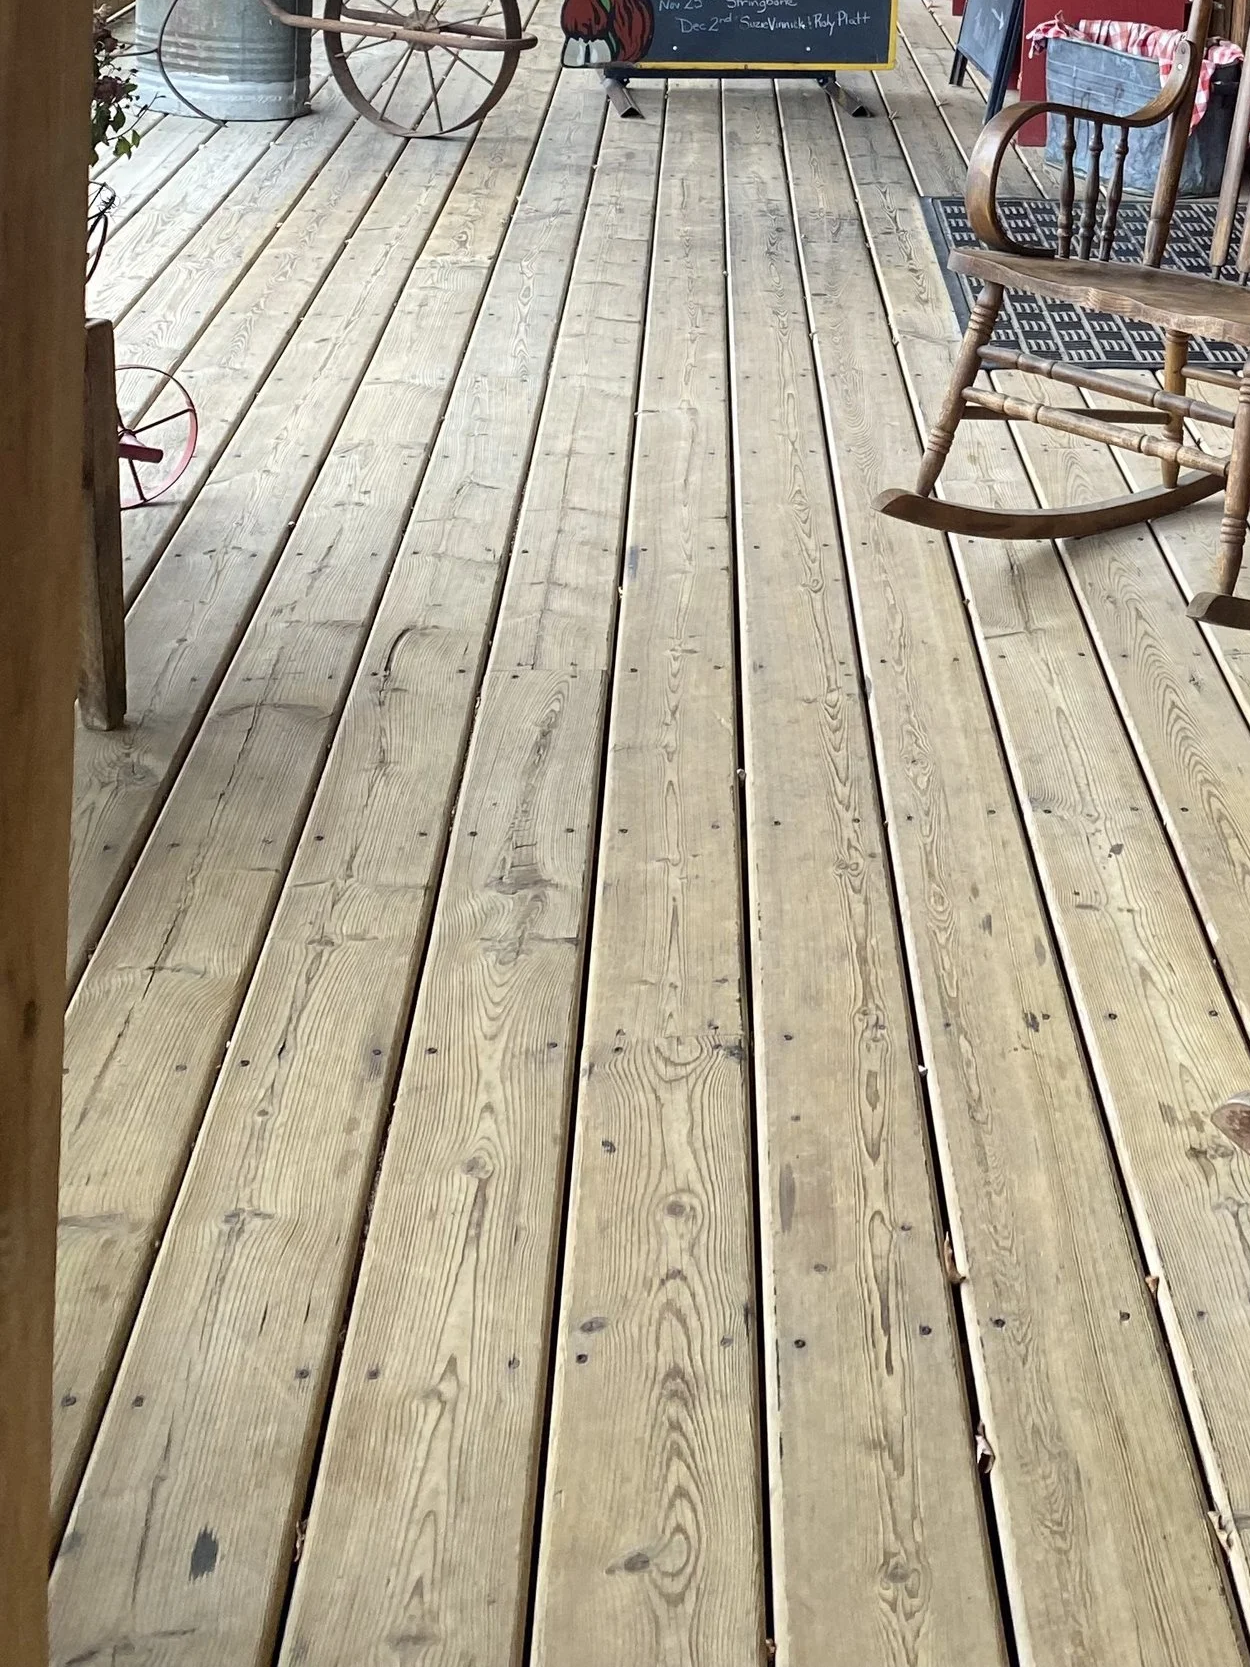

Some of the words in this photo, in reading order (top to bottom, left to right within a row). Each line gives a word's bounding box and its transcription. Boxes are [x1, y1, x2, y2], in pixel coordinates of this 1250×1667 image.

[658, 0, 681, 11] Nov
[675, 16, 707, 33] Dec
[707, 13, 732, 32] 2nd
[837, 10, 871, 26] Platt
